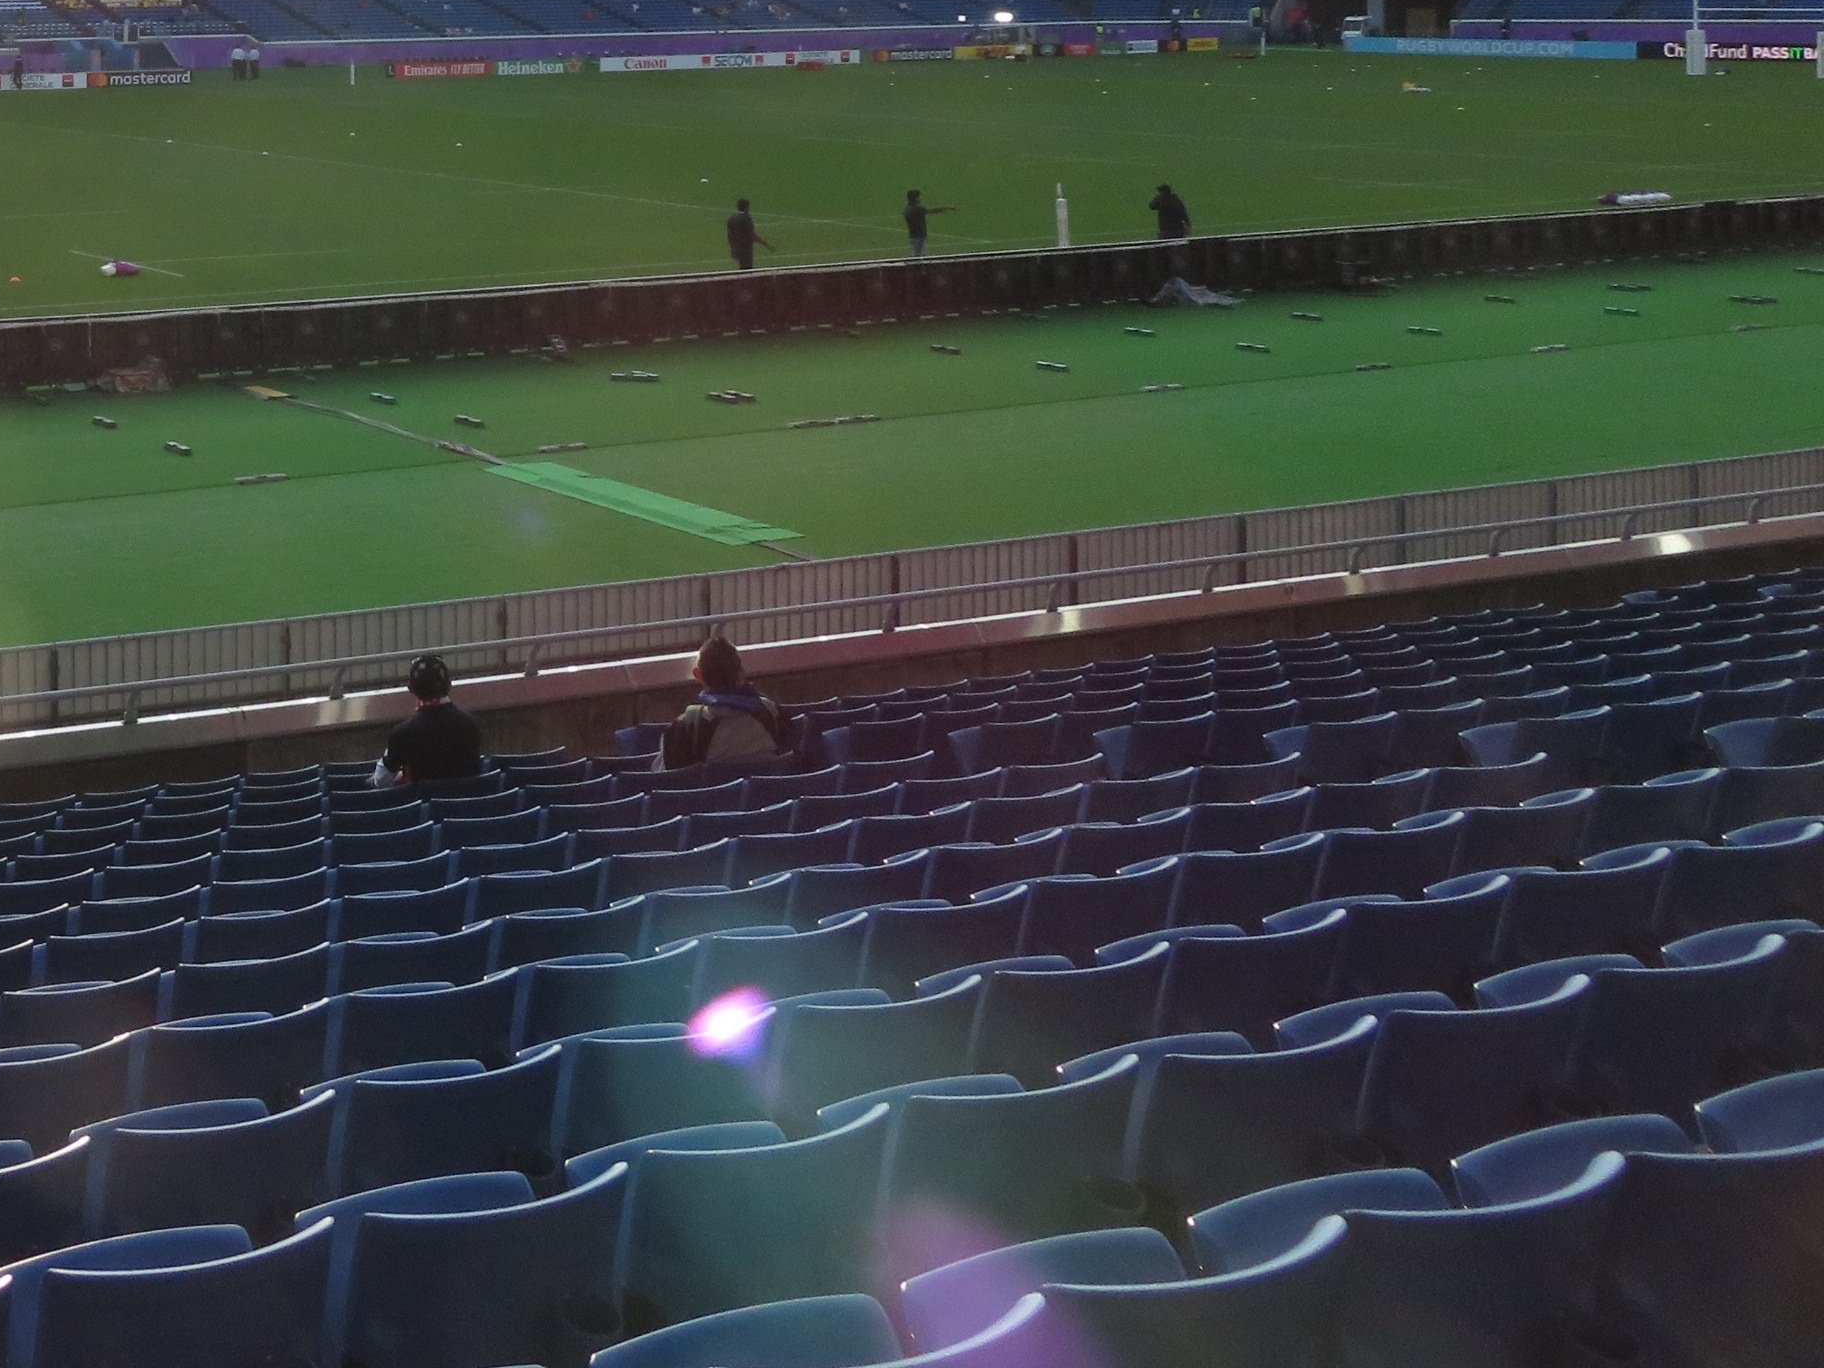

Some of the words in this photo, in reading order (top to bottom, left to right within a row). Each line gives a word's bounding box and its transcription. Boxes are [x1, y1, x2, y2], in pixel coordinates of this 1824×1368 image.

[890, 48, 952, 61] mastercard
[1396, 39, 1574, 56] RUGBYWORLDCUP.COM
[1663, 42, 1748, 59] ChFund
[624, 57, 667, 70] Canon
[714, 54, 753, 67] SECOM
[404, 63, 447, 76] Emirates
[498, 60, 564, 76] Heineken
[109, 70, 192, 86] mastercard
